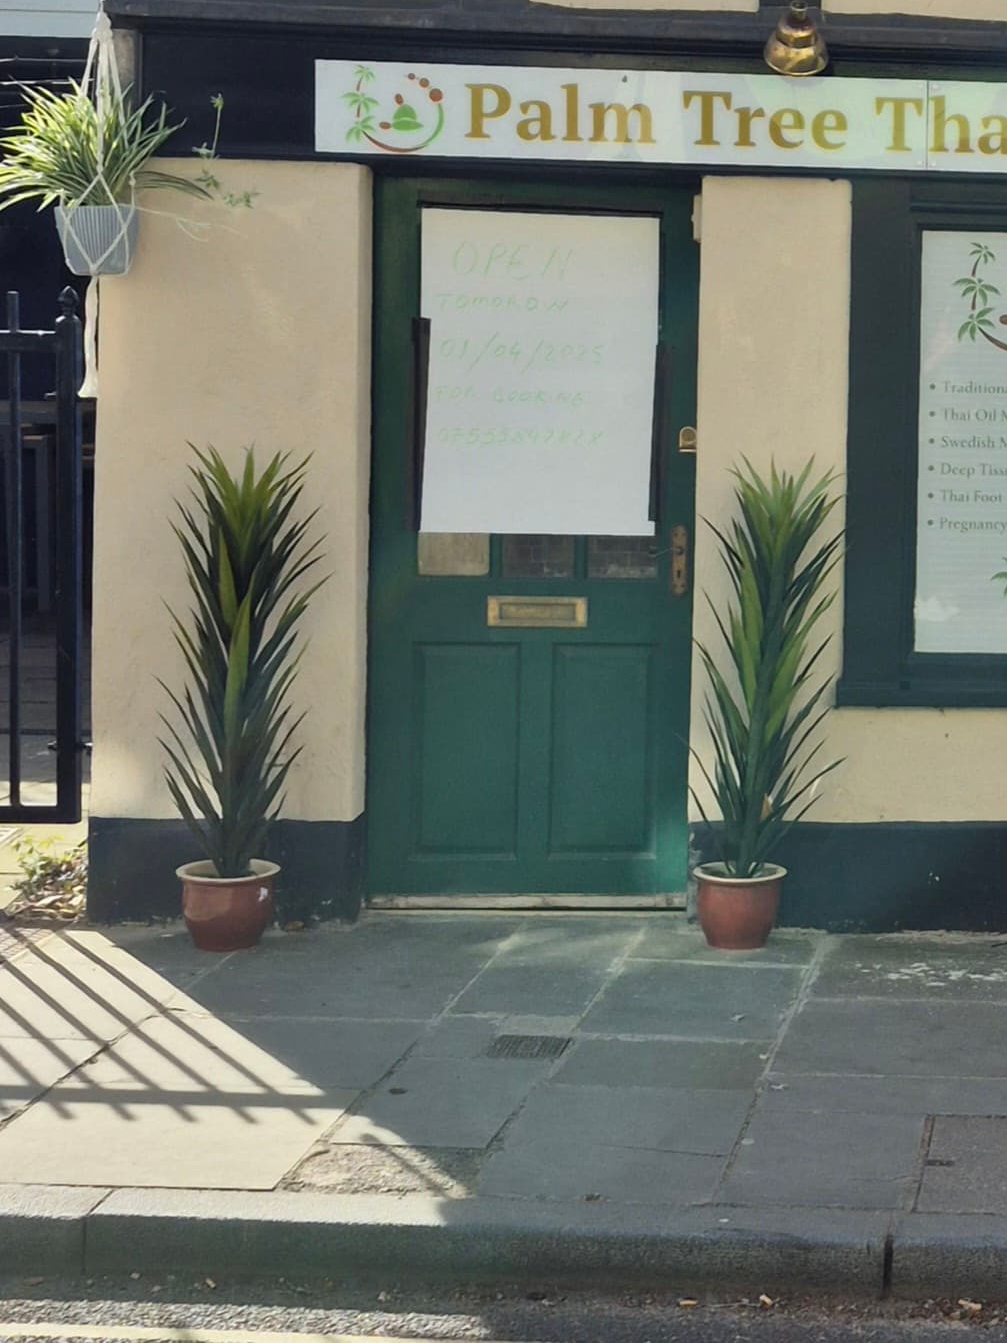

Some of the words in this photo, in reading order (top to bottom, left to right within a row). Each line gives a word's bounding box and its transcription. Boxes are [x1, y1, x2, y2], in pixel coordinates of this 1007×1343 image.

[464, 82, 657, 144] Palm
[682, 89, 848, 152] Tree
[453, 240, 573, 281] OPEN
[942, 408, 972, 423] Thai
[975, 409, 997, 423] Oil
[941, 434, 996, 450] Swedish
[939, 462, 976, 480] Deep
[939, 489, 970, 503] Thai
[973, 490, 1003, 504] Foot
[939, 516, 1007, 534] Pregnancy
